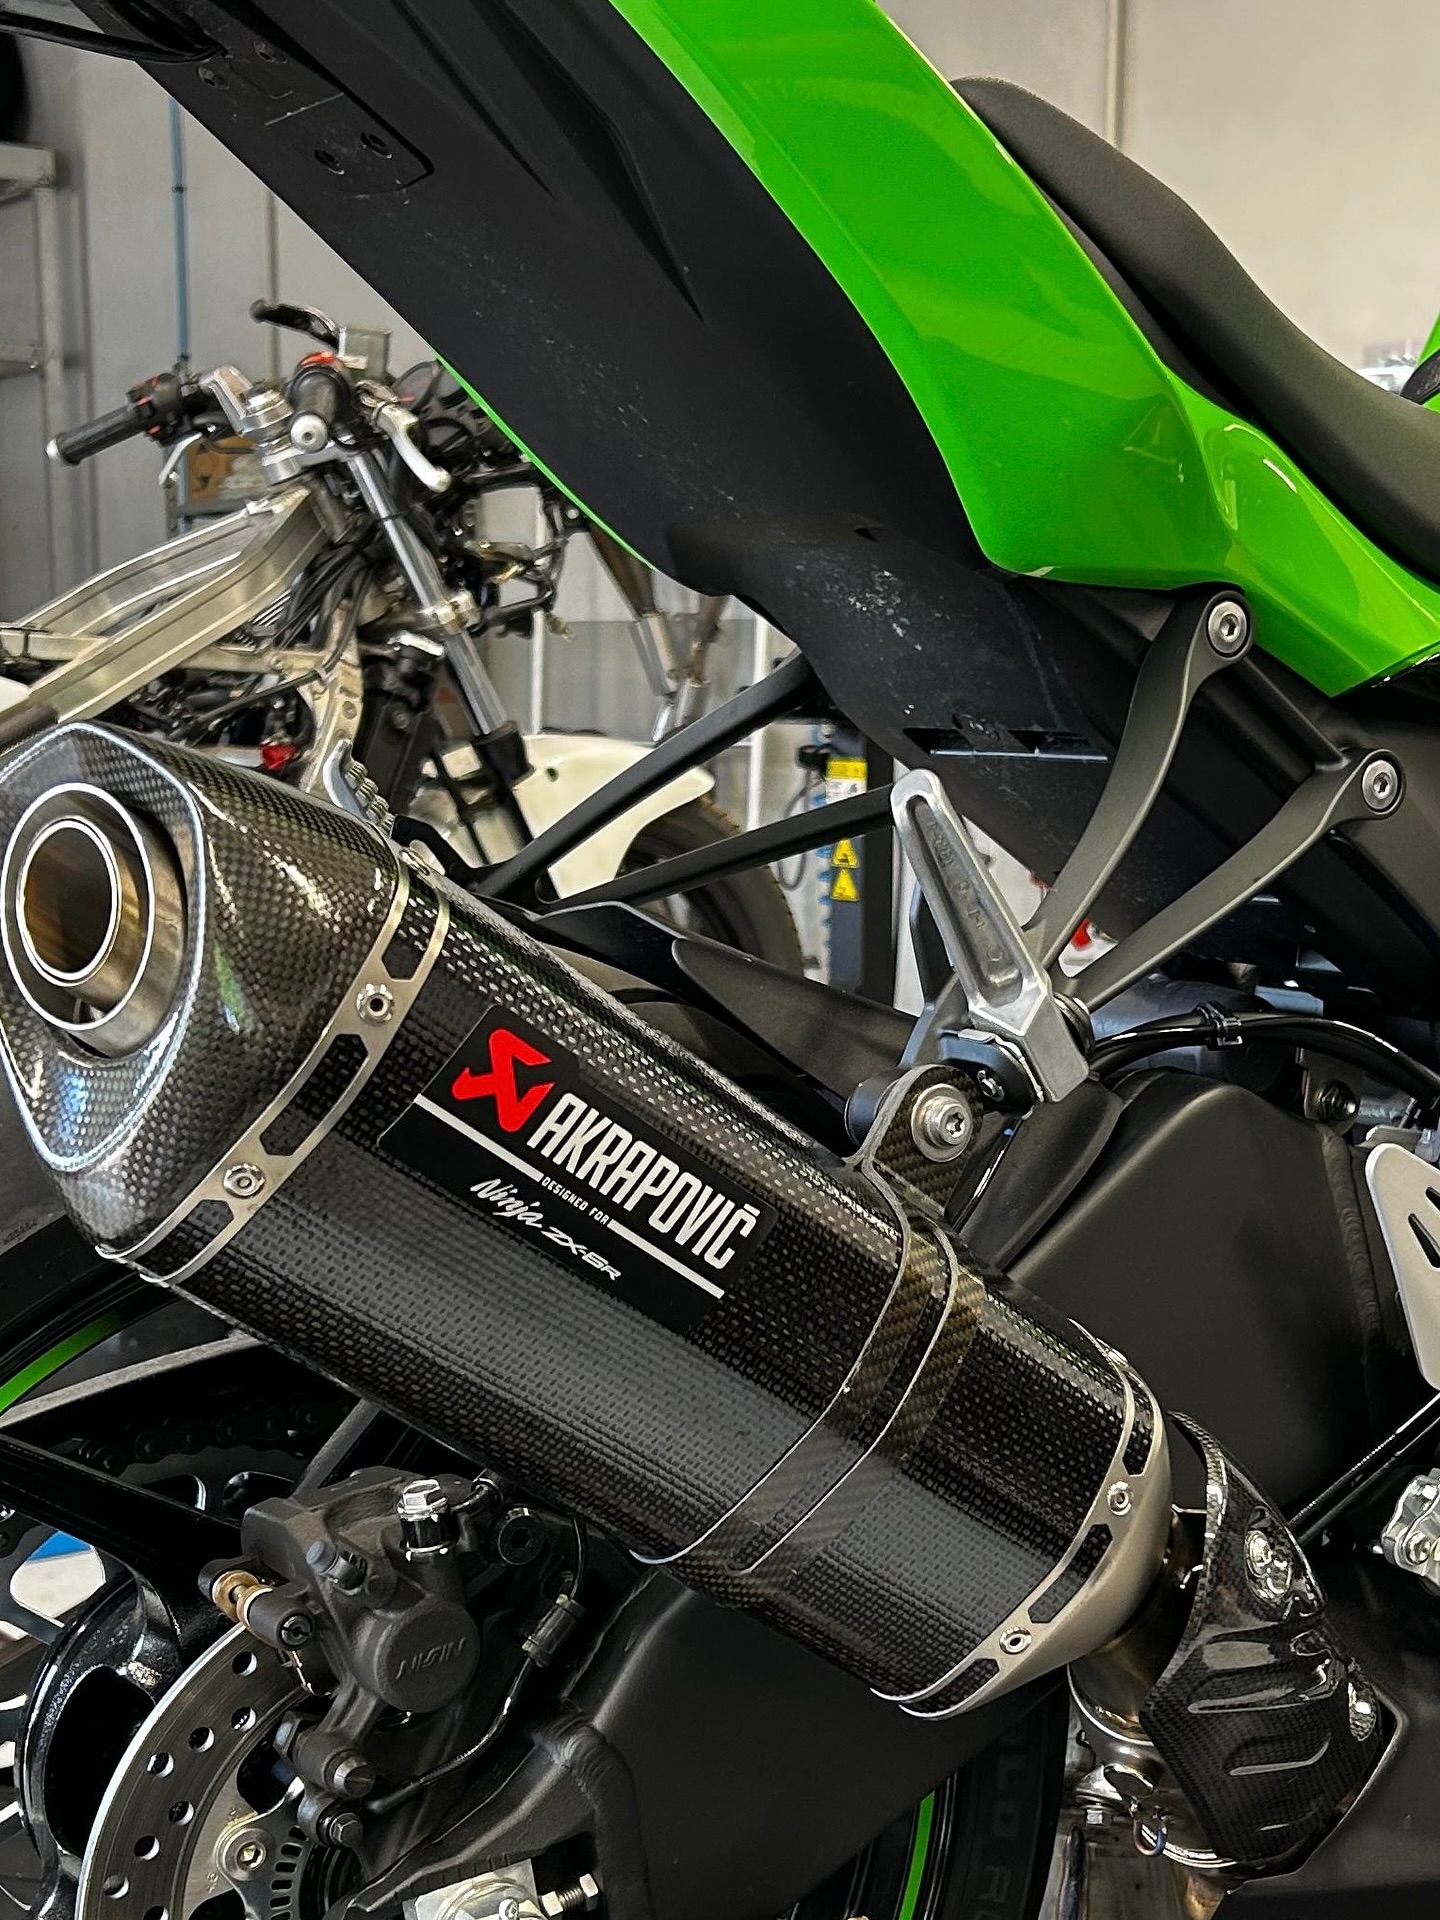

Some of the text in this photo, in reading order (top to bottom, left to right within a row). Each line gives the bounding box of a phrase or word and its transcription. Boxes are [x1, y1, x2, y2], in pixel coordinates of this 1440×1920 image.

[470, 1178, 622, 1281] Ninja ZX-6R
[541, 1176, 610, 1226] DESIGNED FOR
